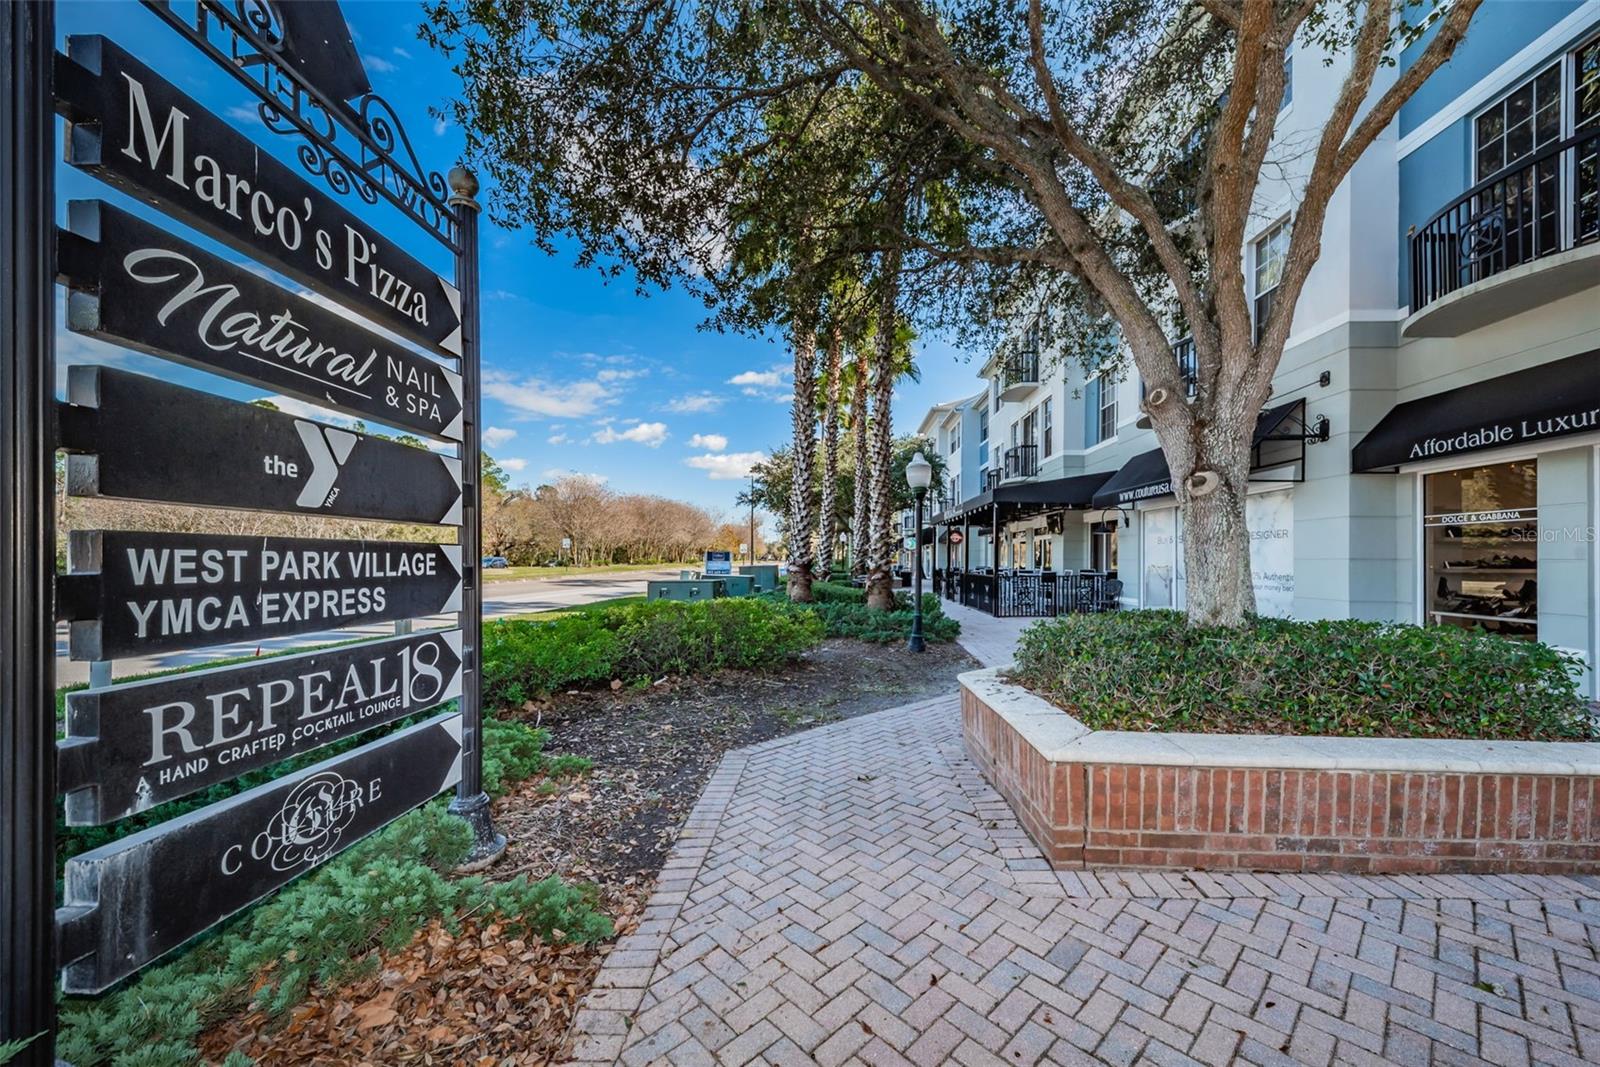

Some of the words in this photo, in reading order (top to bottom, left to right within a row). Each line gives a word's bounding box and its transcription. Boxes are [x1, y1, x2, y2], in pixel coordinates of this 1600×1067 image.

[120, 71, 332, 270] Marco's
[344, 224, 430, 327] Pizza
[123, 248, 377, 386] Natural
[387, 355, 441, 399] NAIL
[386, 386, 399, 408] &
[406, 393, 442, 423] SPA
[1409, 425, 1514, 458] Affordable
[1521, 408, 1600, 439] Luxur
[263, 455, 298, 478] the
[324, 487, 341, 508] YMCA
[1441, 514, 1468, 523] DOLCE
[1470, 513, 1477, 522] &
[1479, 511, 1521, 522] GABBANA
[1250, 529, 1289, 540] ESIGNER
[126, 548, 248, 586] WEST
[261, 550, 340, 581] PARK
[348, 552, 437, 577] VILLAGE
[127, 595, 250, 638] YMCA
[261, 586, 386, 625] EXPRESS
[135, 776, 150, 794] A
[159, 757, 209, 786] HAND
[217, 733, 286, 765] CRAFTED
[292, 709, 355, 740] COCKTAIL
[359, 695, 401, 718] LOUNGE
